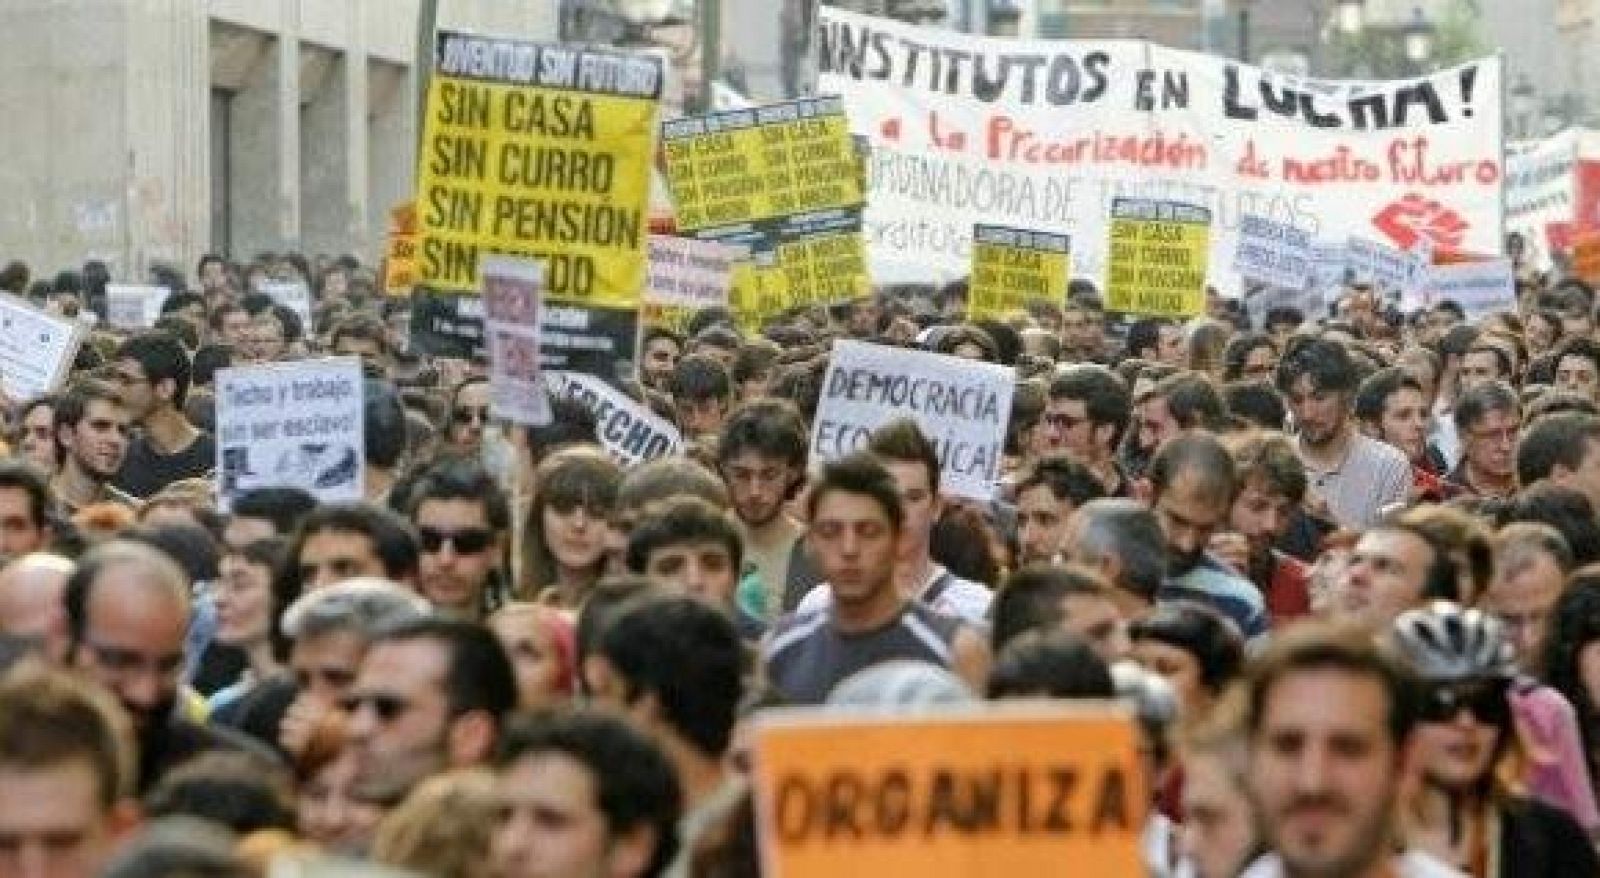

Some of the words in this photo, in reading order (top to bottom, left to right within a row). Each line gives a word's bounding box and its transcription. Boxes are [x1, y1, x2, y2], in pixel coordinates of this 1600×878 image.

[819, 22, 1111, 105] INSTITUTOS
[1136, 67, 1189, 111] EN
[438, 82, 491, 129] SIN
[504, 90, 594, 140] CASA
[430, 134, 487, 181] SIN
[499, 143, 615, 194] CURRO
[1282, 145, 1378, 183] nuestro
[1387, 135, 1496, 183] futuro
[425, 185, 482, 233] SIN
[493, 195, 641, 250] PENSIÓN
[421, 237, 477, 283] SIN
[777, 762, 1127, 848] ORGANIZA
